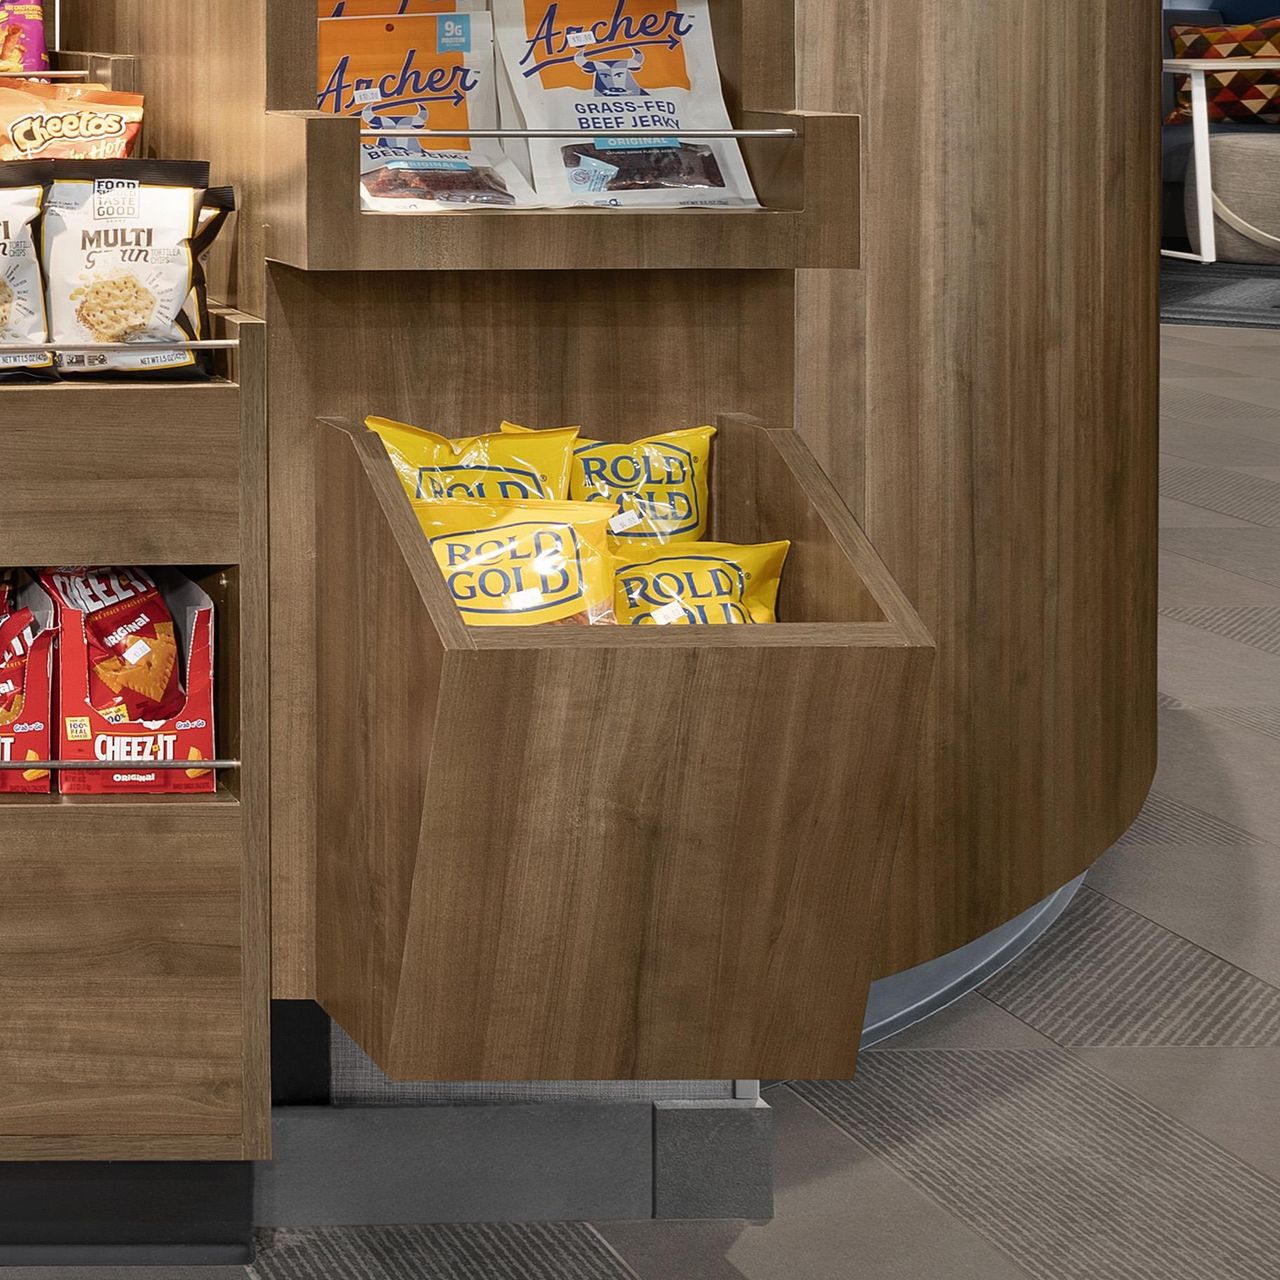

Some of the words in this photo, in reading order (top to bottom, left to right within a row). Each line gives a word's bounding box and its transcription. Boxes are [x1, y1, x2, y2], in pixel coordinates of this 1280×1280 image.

[444, 21, 462, 37] 9G
[317, 49, 479, 114] Archer
[574, 100, 676, 116] GRASS-FED
[578, 116, 625, 129] BEEF
[631, 114, 680, 130] JERKY
[11, 111, 124, 153] Cheetos
[608, 136, 667, 146] ORIGINAL
[97, 206, 136, 217] GOOD
[81, 227, 153, 250] MULTI
[580, 456, 687, 489] ROLD
[447, 530, 564, 566] ROLD
[447, 567, 570, 601] GOLD
[620, 568, 733, 609] ROLD
